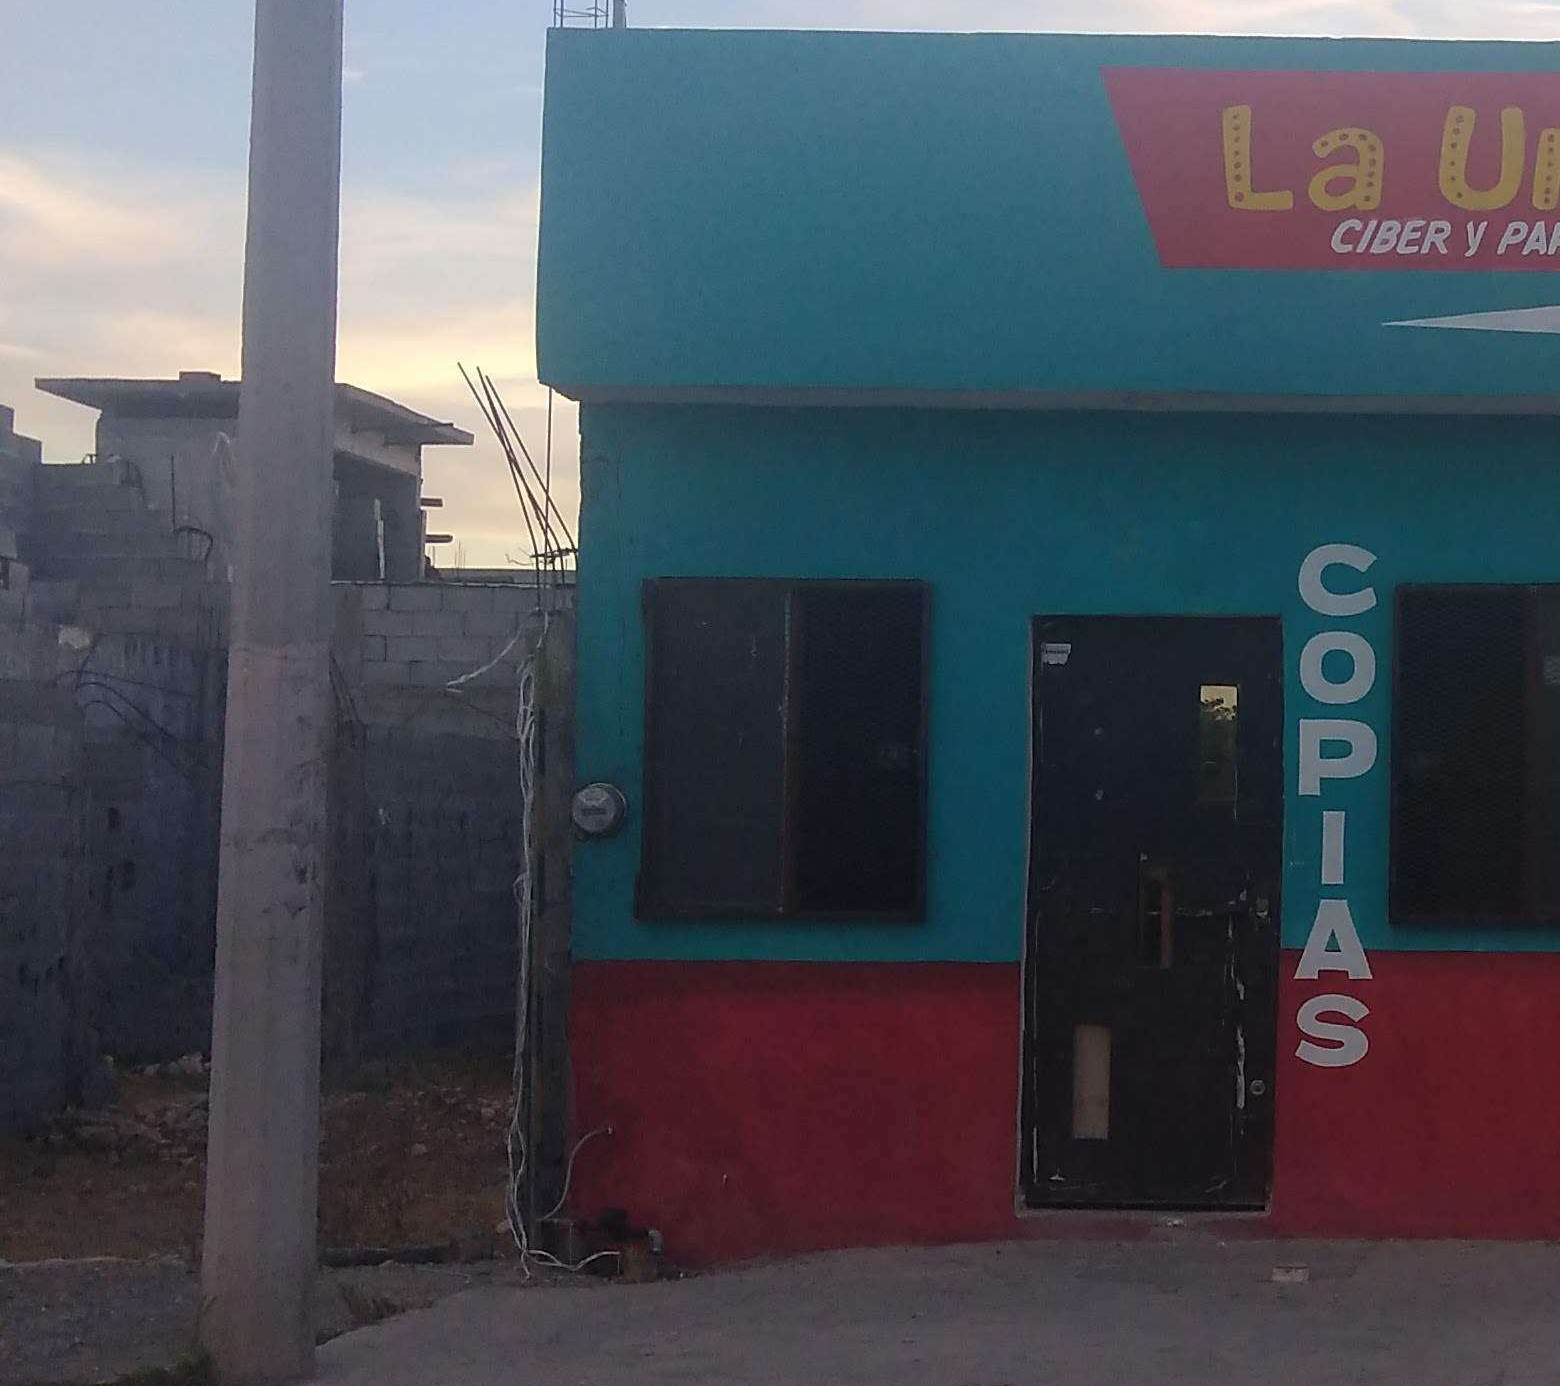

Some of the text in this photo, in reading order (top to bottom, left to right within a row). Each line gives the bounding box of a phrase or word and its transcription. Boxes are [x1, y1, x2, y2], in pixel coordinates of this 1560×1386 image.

[1222, 105, 1384, 211] La
[1330, 218, 1452, 256] CIBER
[1293, 543, 1378, 1068] COPIAS
